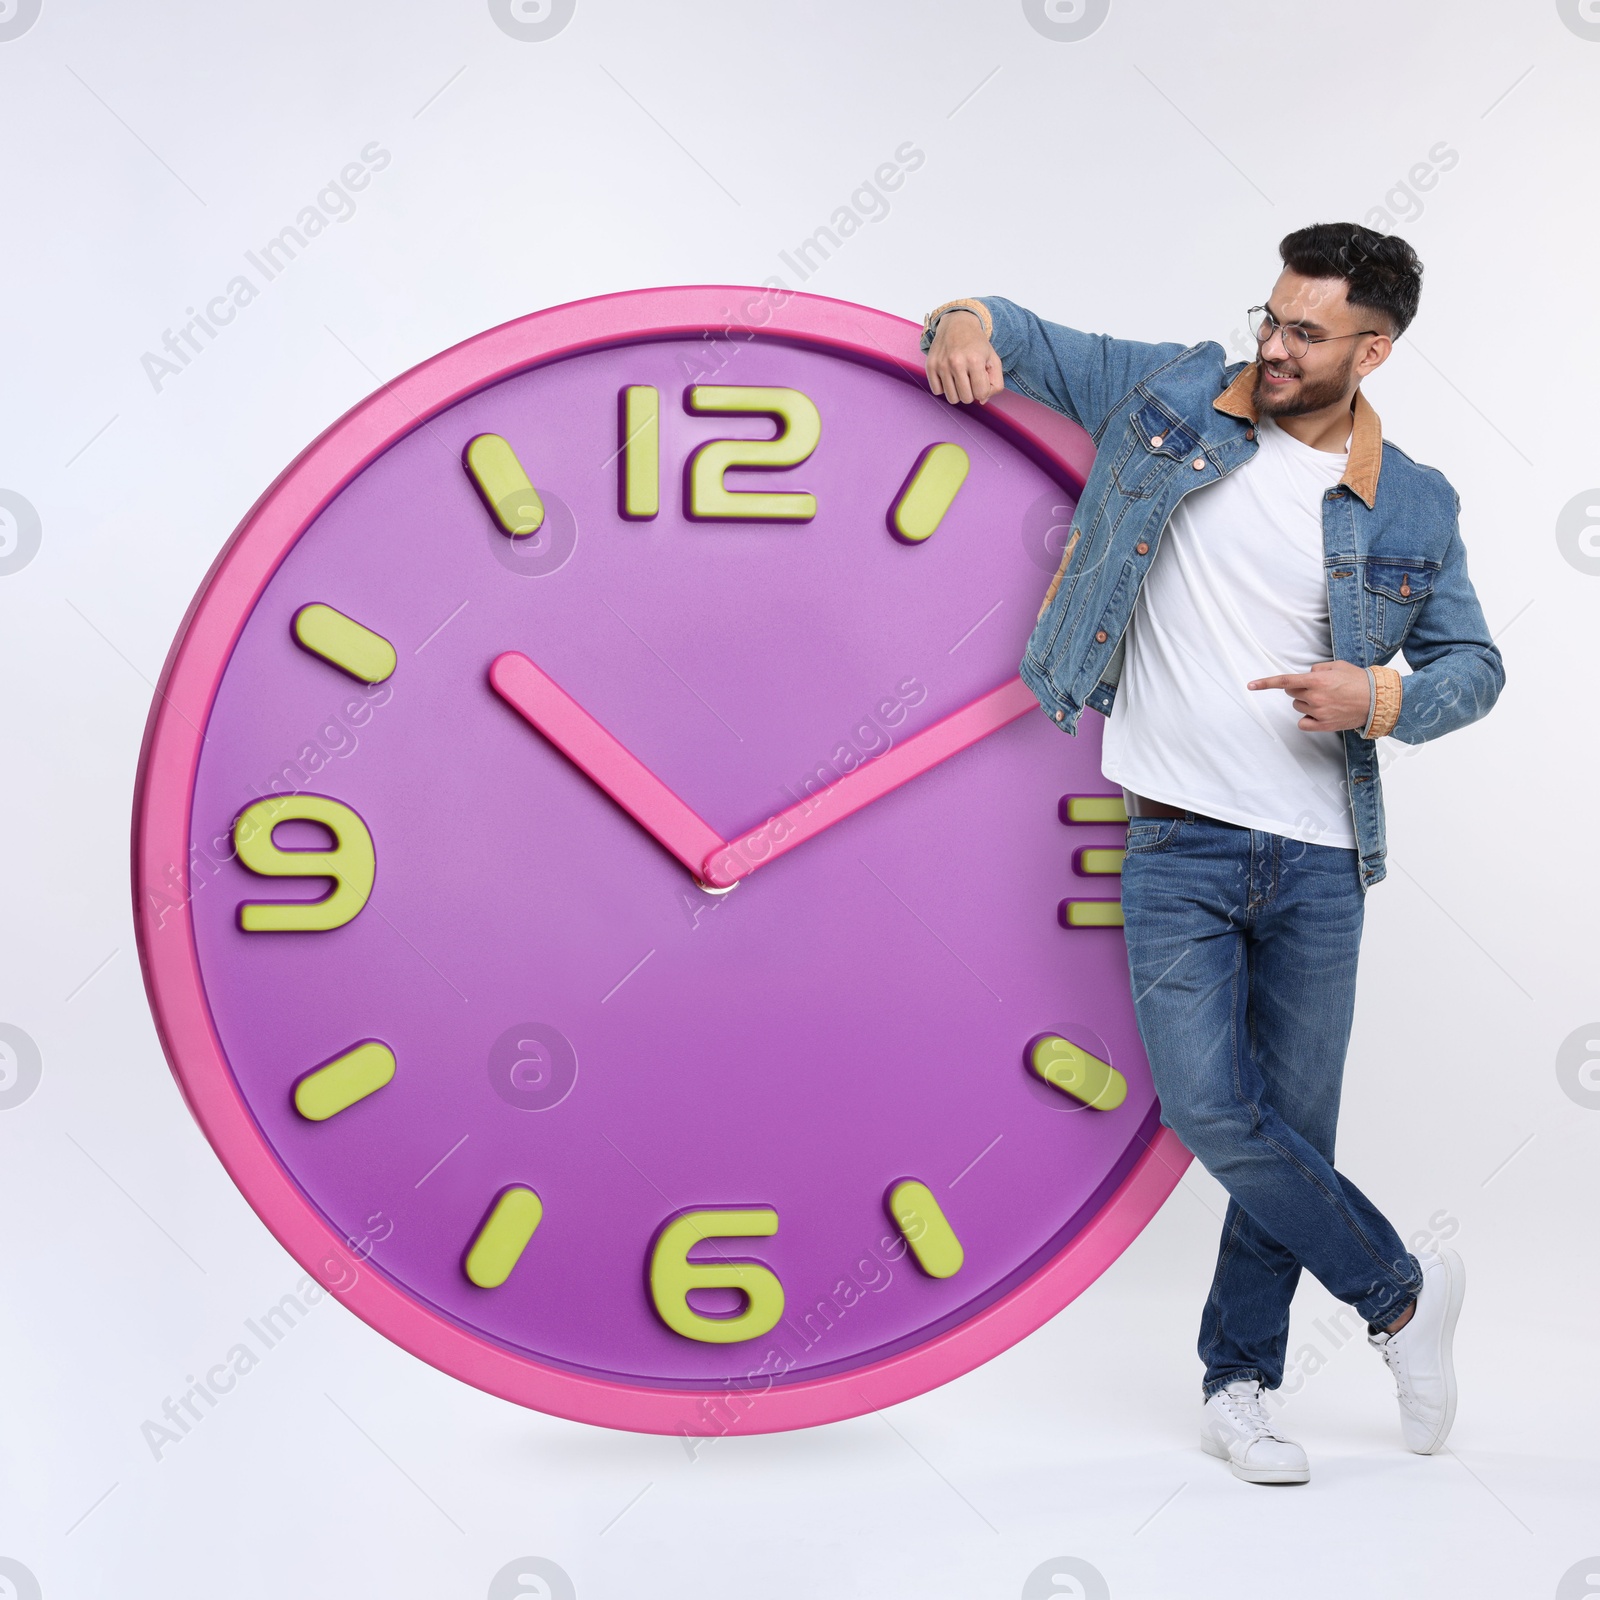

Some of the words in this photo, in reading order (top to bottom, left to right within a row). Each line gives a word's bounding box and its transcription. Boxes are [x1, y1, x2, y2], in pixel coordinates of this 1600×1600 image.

[622, 384, 822, 520] 12
[235, 794, 376, 932] 9
[650, 1209, 786, 1344] 6
